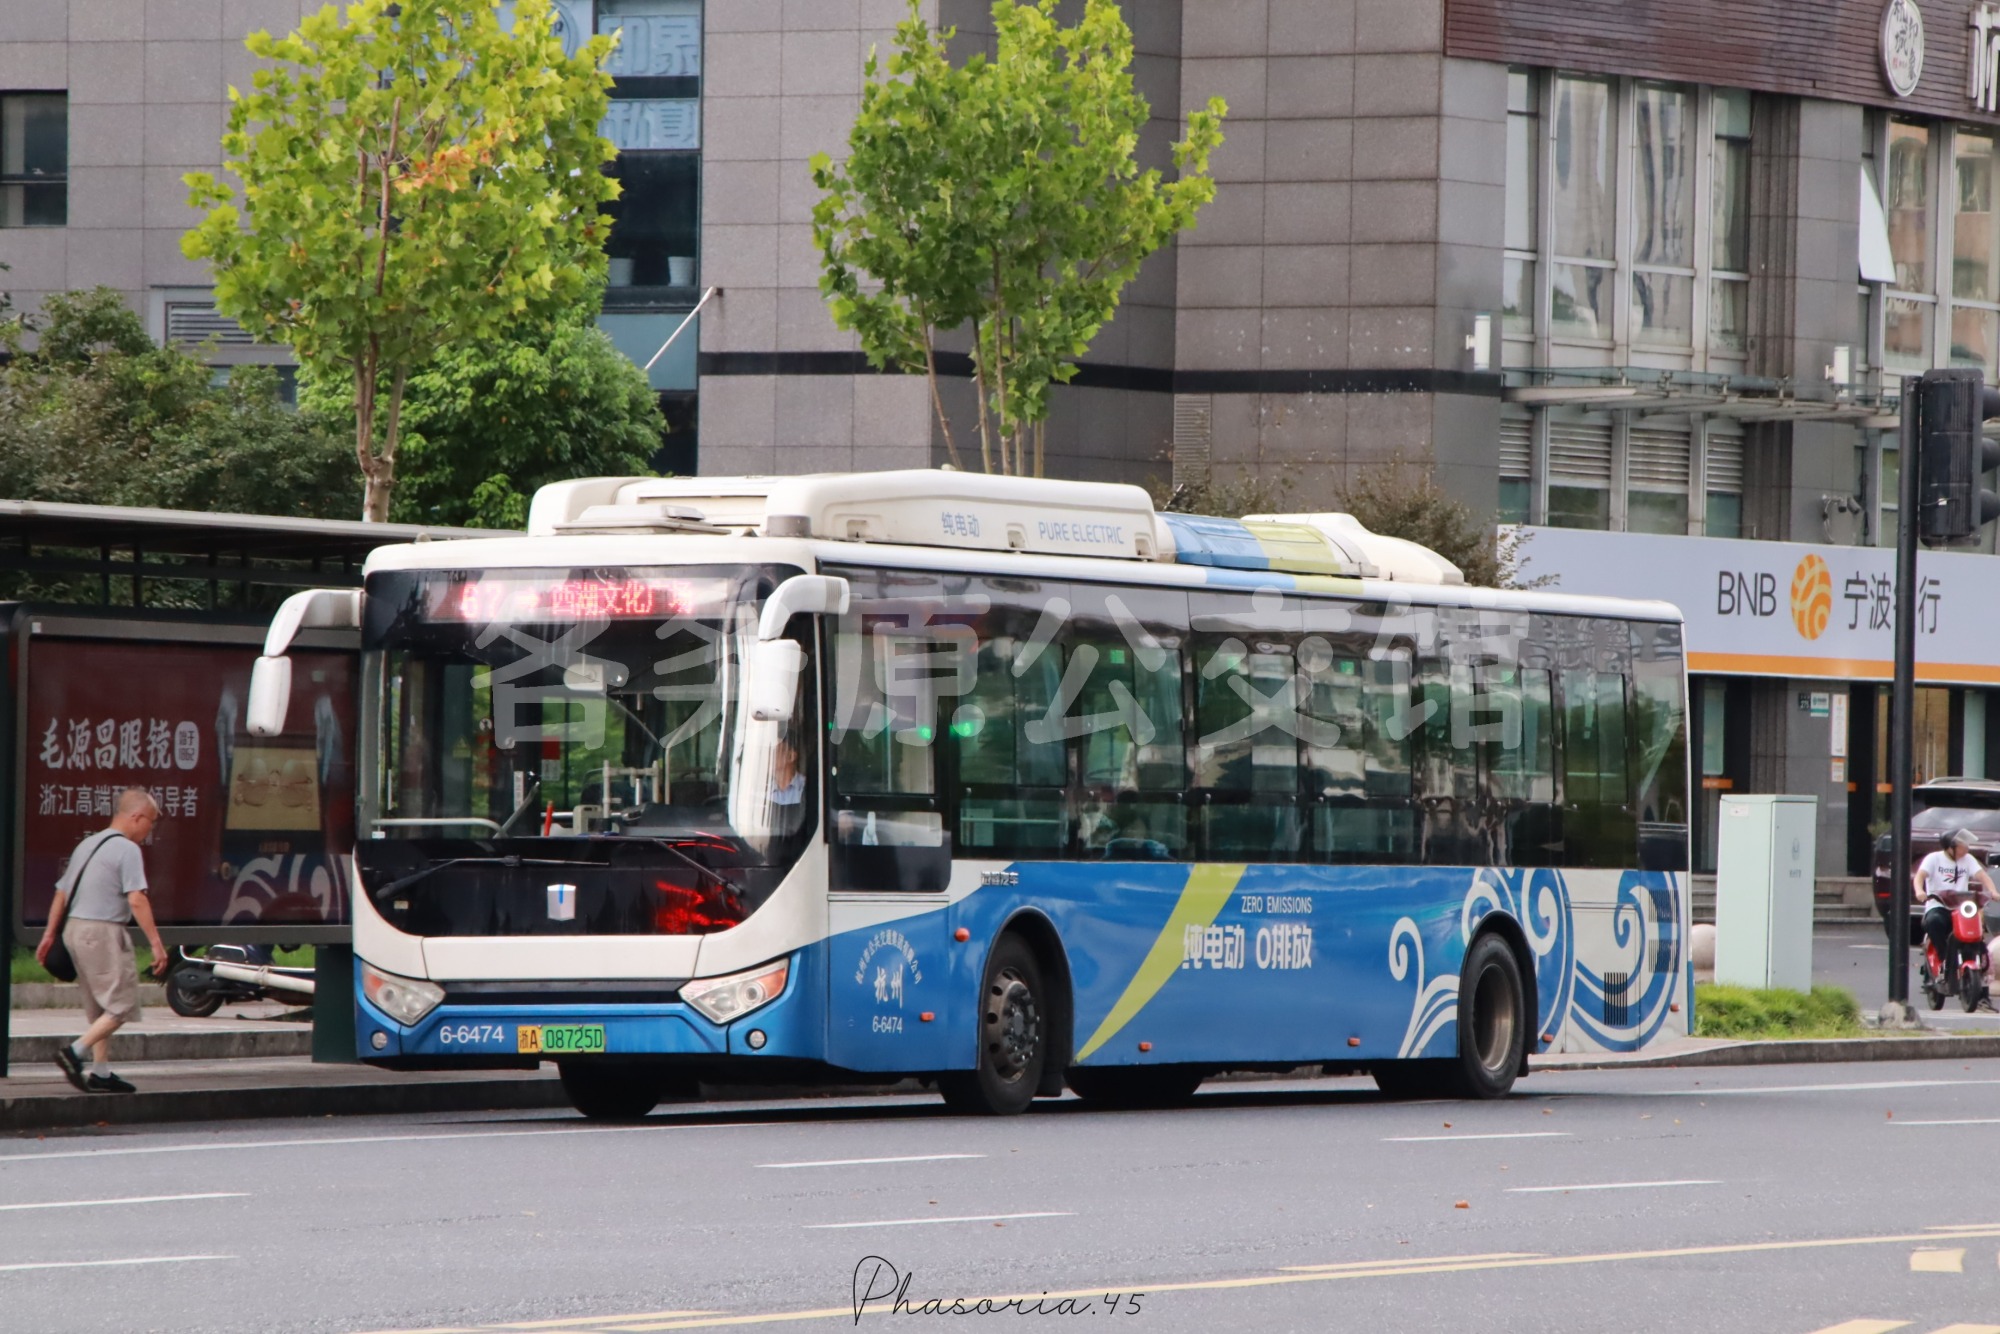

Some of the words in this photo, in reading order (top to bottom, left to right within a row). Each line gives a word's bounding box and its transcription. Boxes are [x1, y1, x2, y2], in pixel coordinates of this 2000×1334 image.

[942, 511, 980, 538] 纯电动
[1039, 521, 1070, 541] PURE
[1072, 523, 1124, 545] ELECTRIC
[551, 581, 692, 616] 西湖文化广场
[1717, 570, 1777, 617] BNB
[1844, 571, 1942, 634] 宁波行
[39, 717, 172, 770] 毛源昌眼镜
[39, 784, 198, 817] 浙江高端领导者
[1241, 895, 1264, 914] ZERO
[1266, 895, 1313, 914] EMISSIONS
[1182, 923, 1245, 969] 纯电动
[873, 963, 903, 1009] 杭州
[439, 1025, 505, 1044] 6-6474
[872, 1015, 903, 1035] 6-6474
